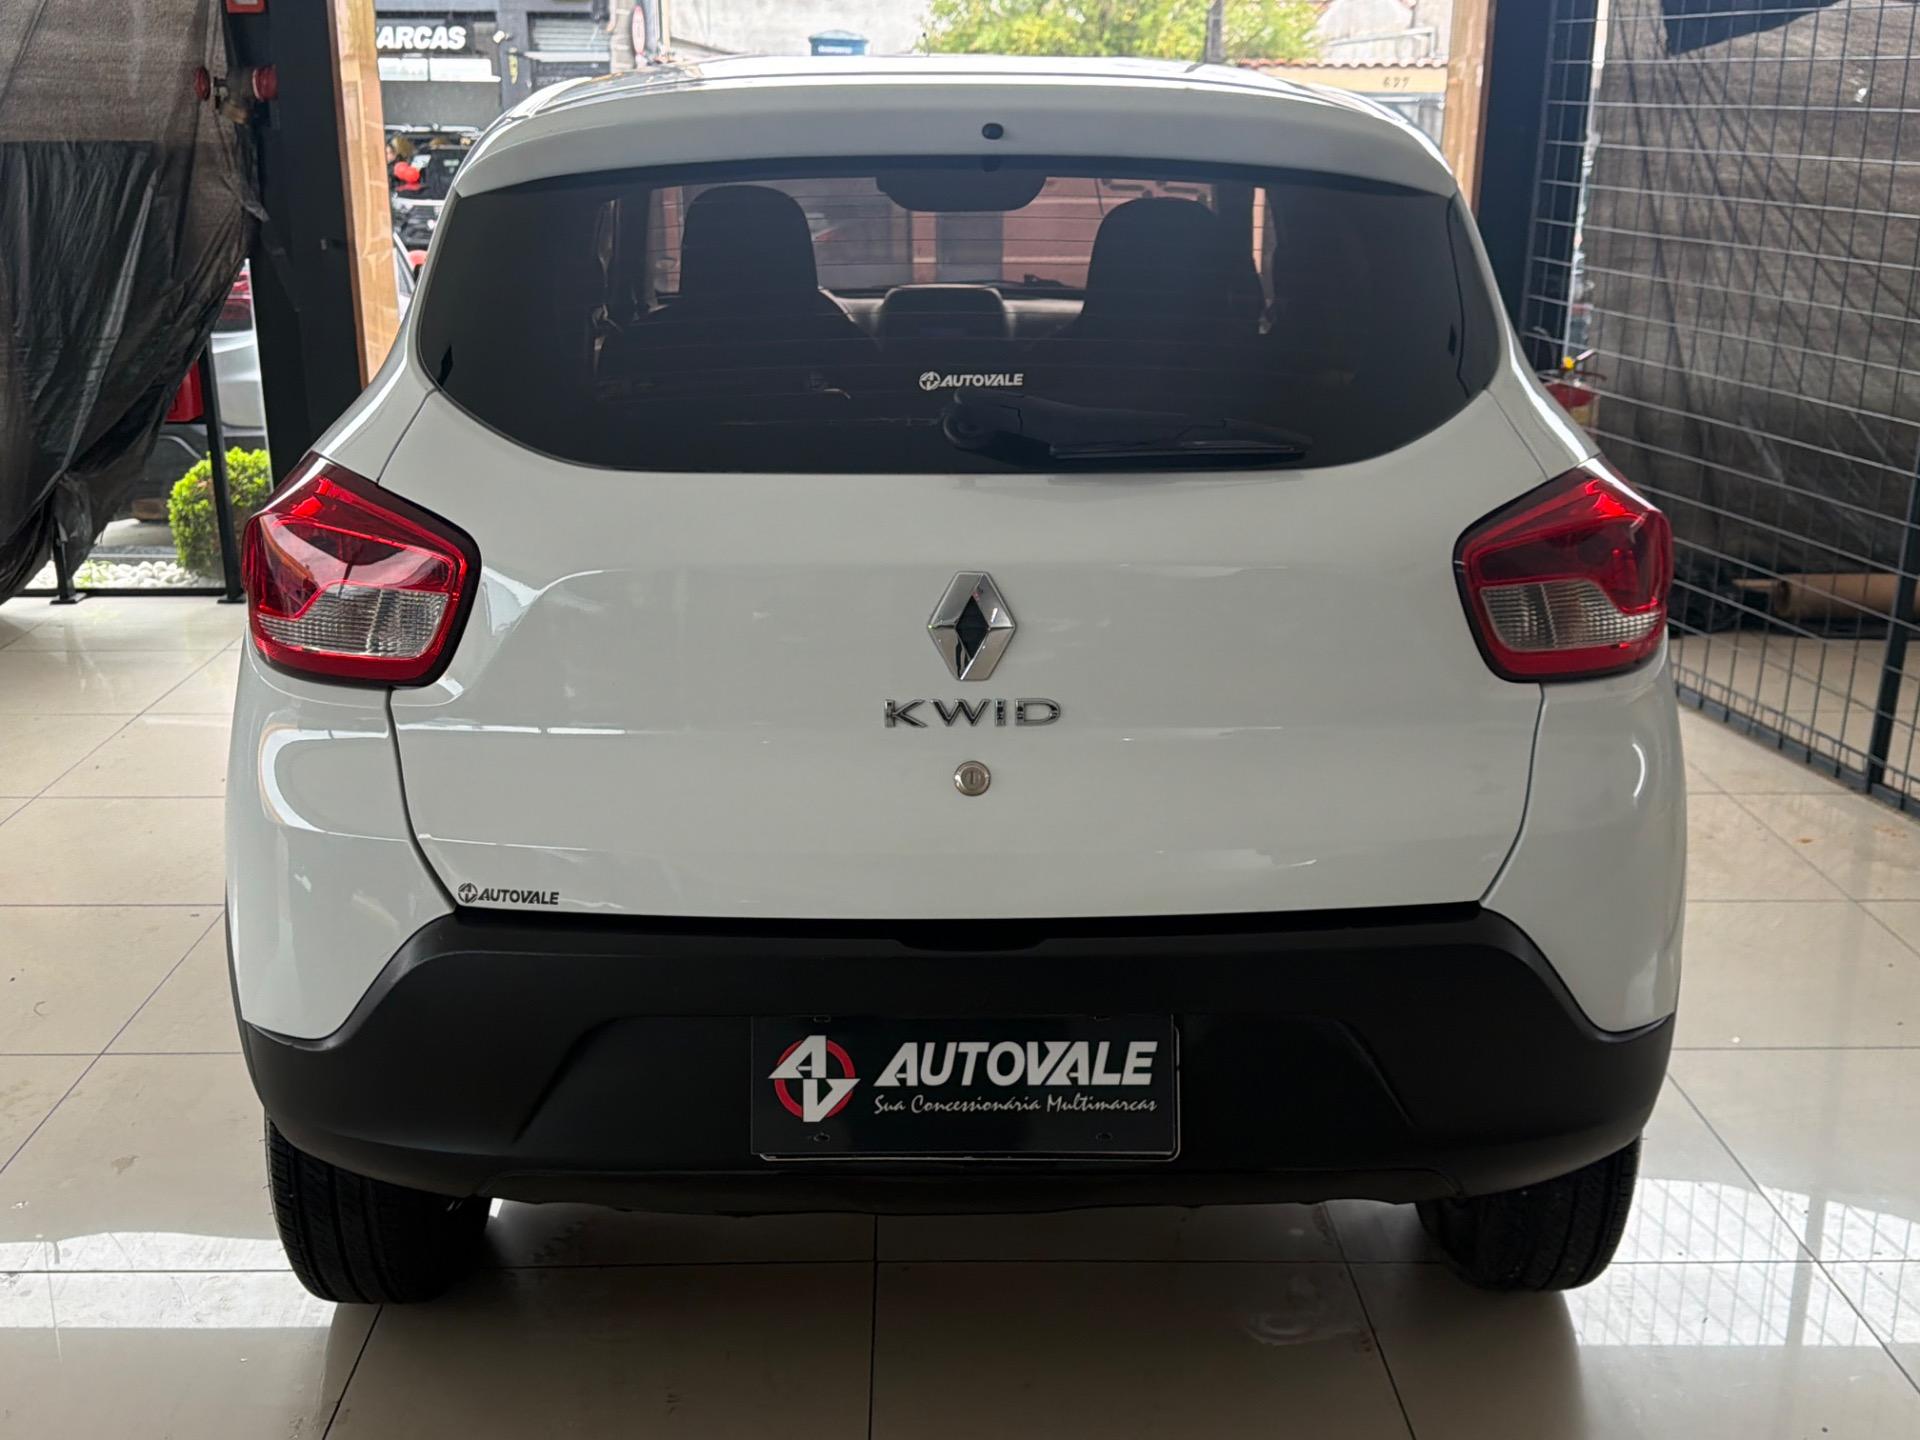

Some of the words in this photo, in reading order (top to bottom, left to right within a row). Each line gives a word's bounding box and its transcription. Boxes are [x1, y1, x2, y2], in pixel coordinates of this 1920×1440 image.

[376, 25, 467, 50] ARCAS
[939, 373, 1024, 388] AUTOVALE
[884, 698, 1061, 728] KWID
[478, 888, 560, 905] AUTOVALE
[873, 1041, 1158, 1087] AUTOVALE
[874, 1094, 906, 1114] Sua
[910, 1094, 1042, 1114] Concessionária
[1046, 1093, 1158, 1113] Multimarcas
